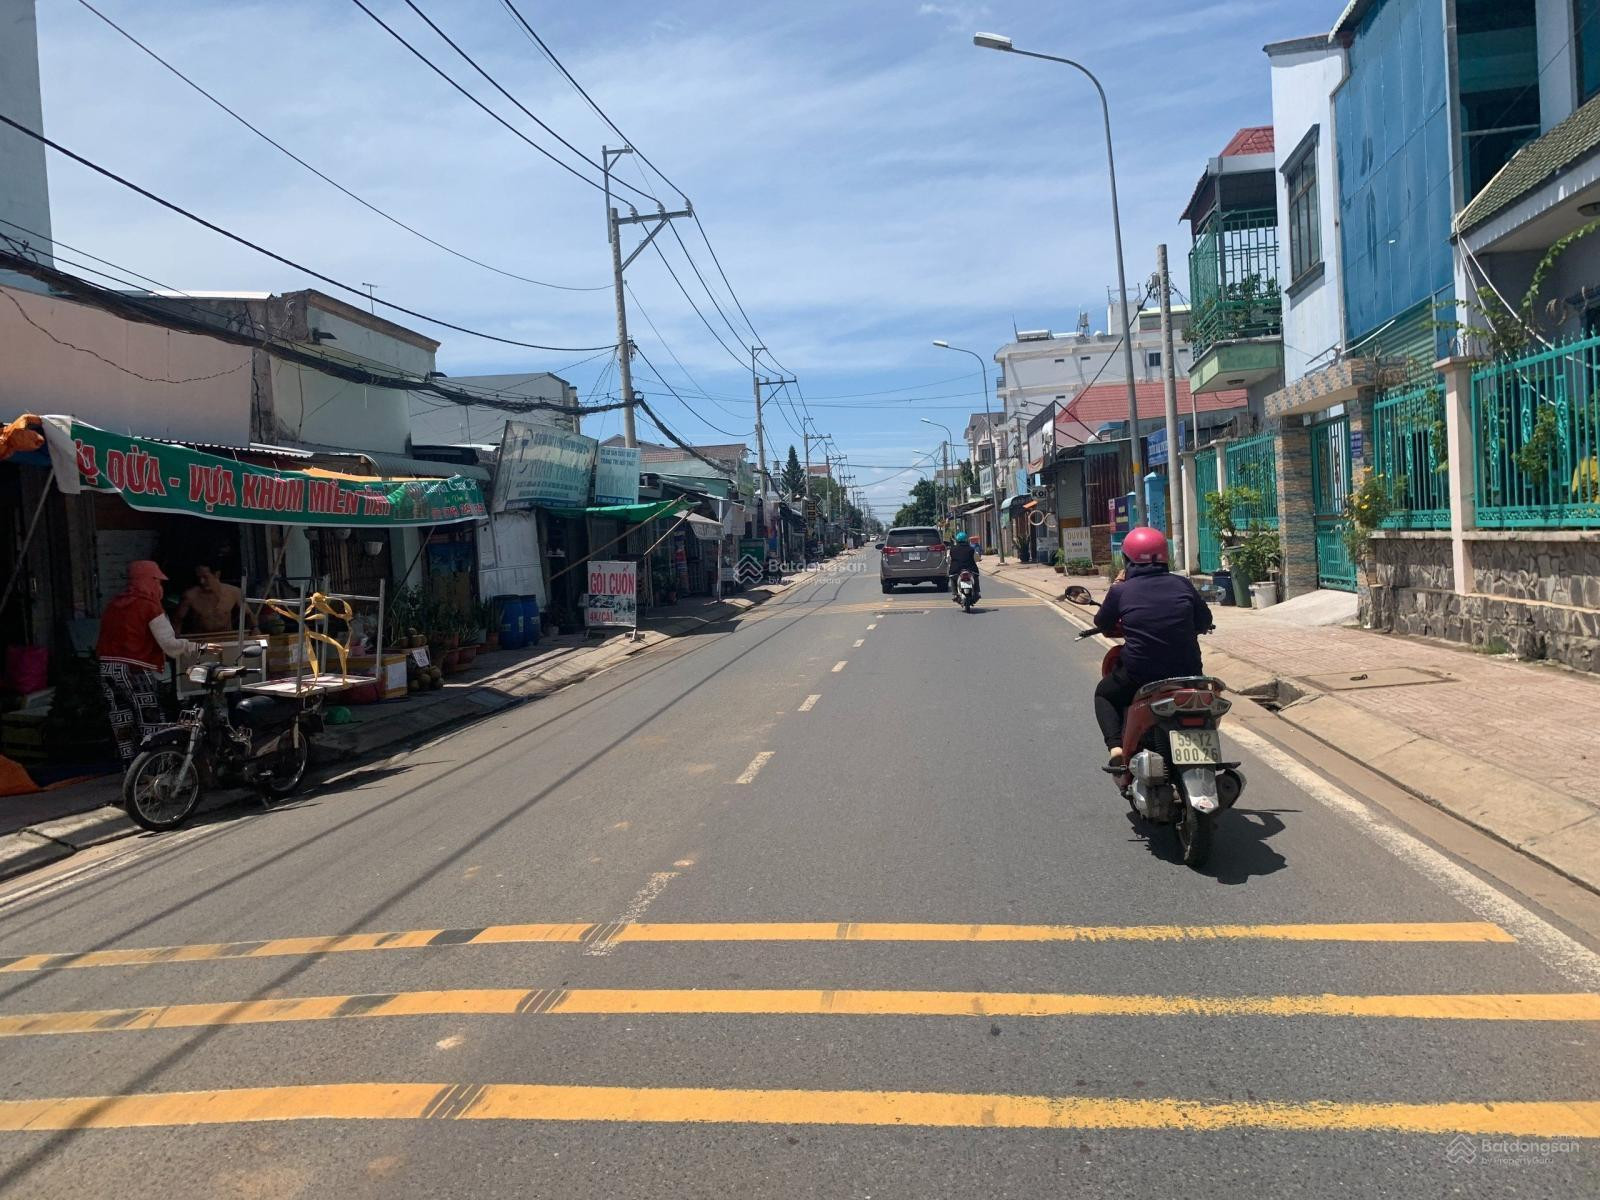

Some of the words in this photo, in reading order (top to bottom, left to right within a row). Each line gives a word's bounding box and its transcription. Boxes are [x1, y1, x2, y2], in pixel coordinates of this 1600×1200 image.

[188, 464, 237, 512] VỰA
[591, 564, 606, 595] GỎI
[609, 564, 635, 595] CUỐN
